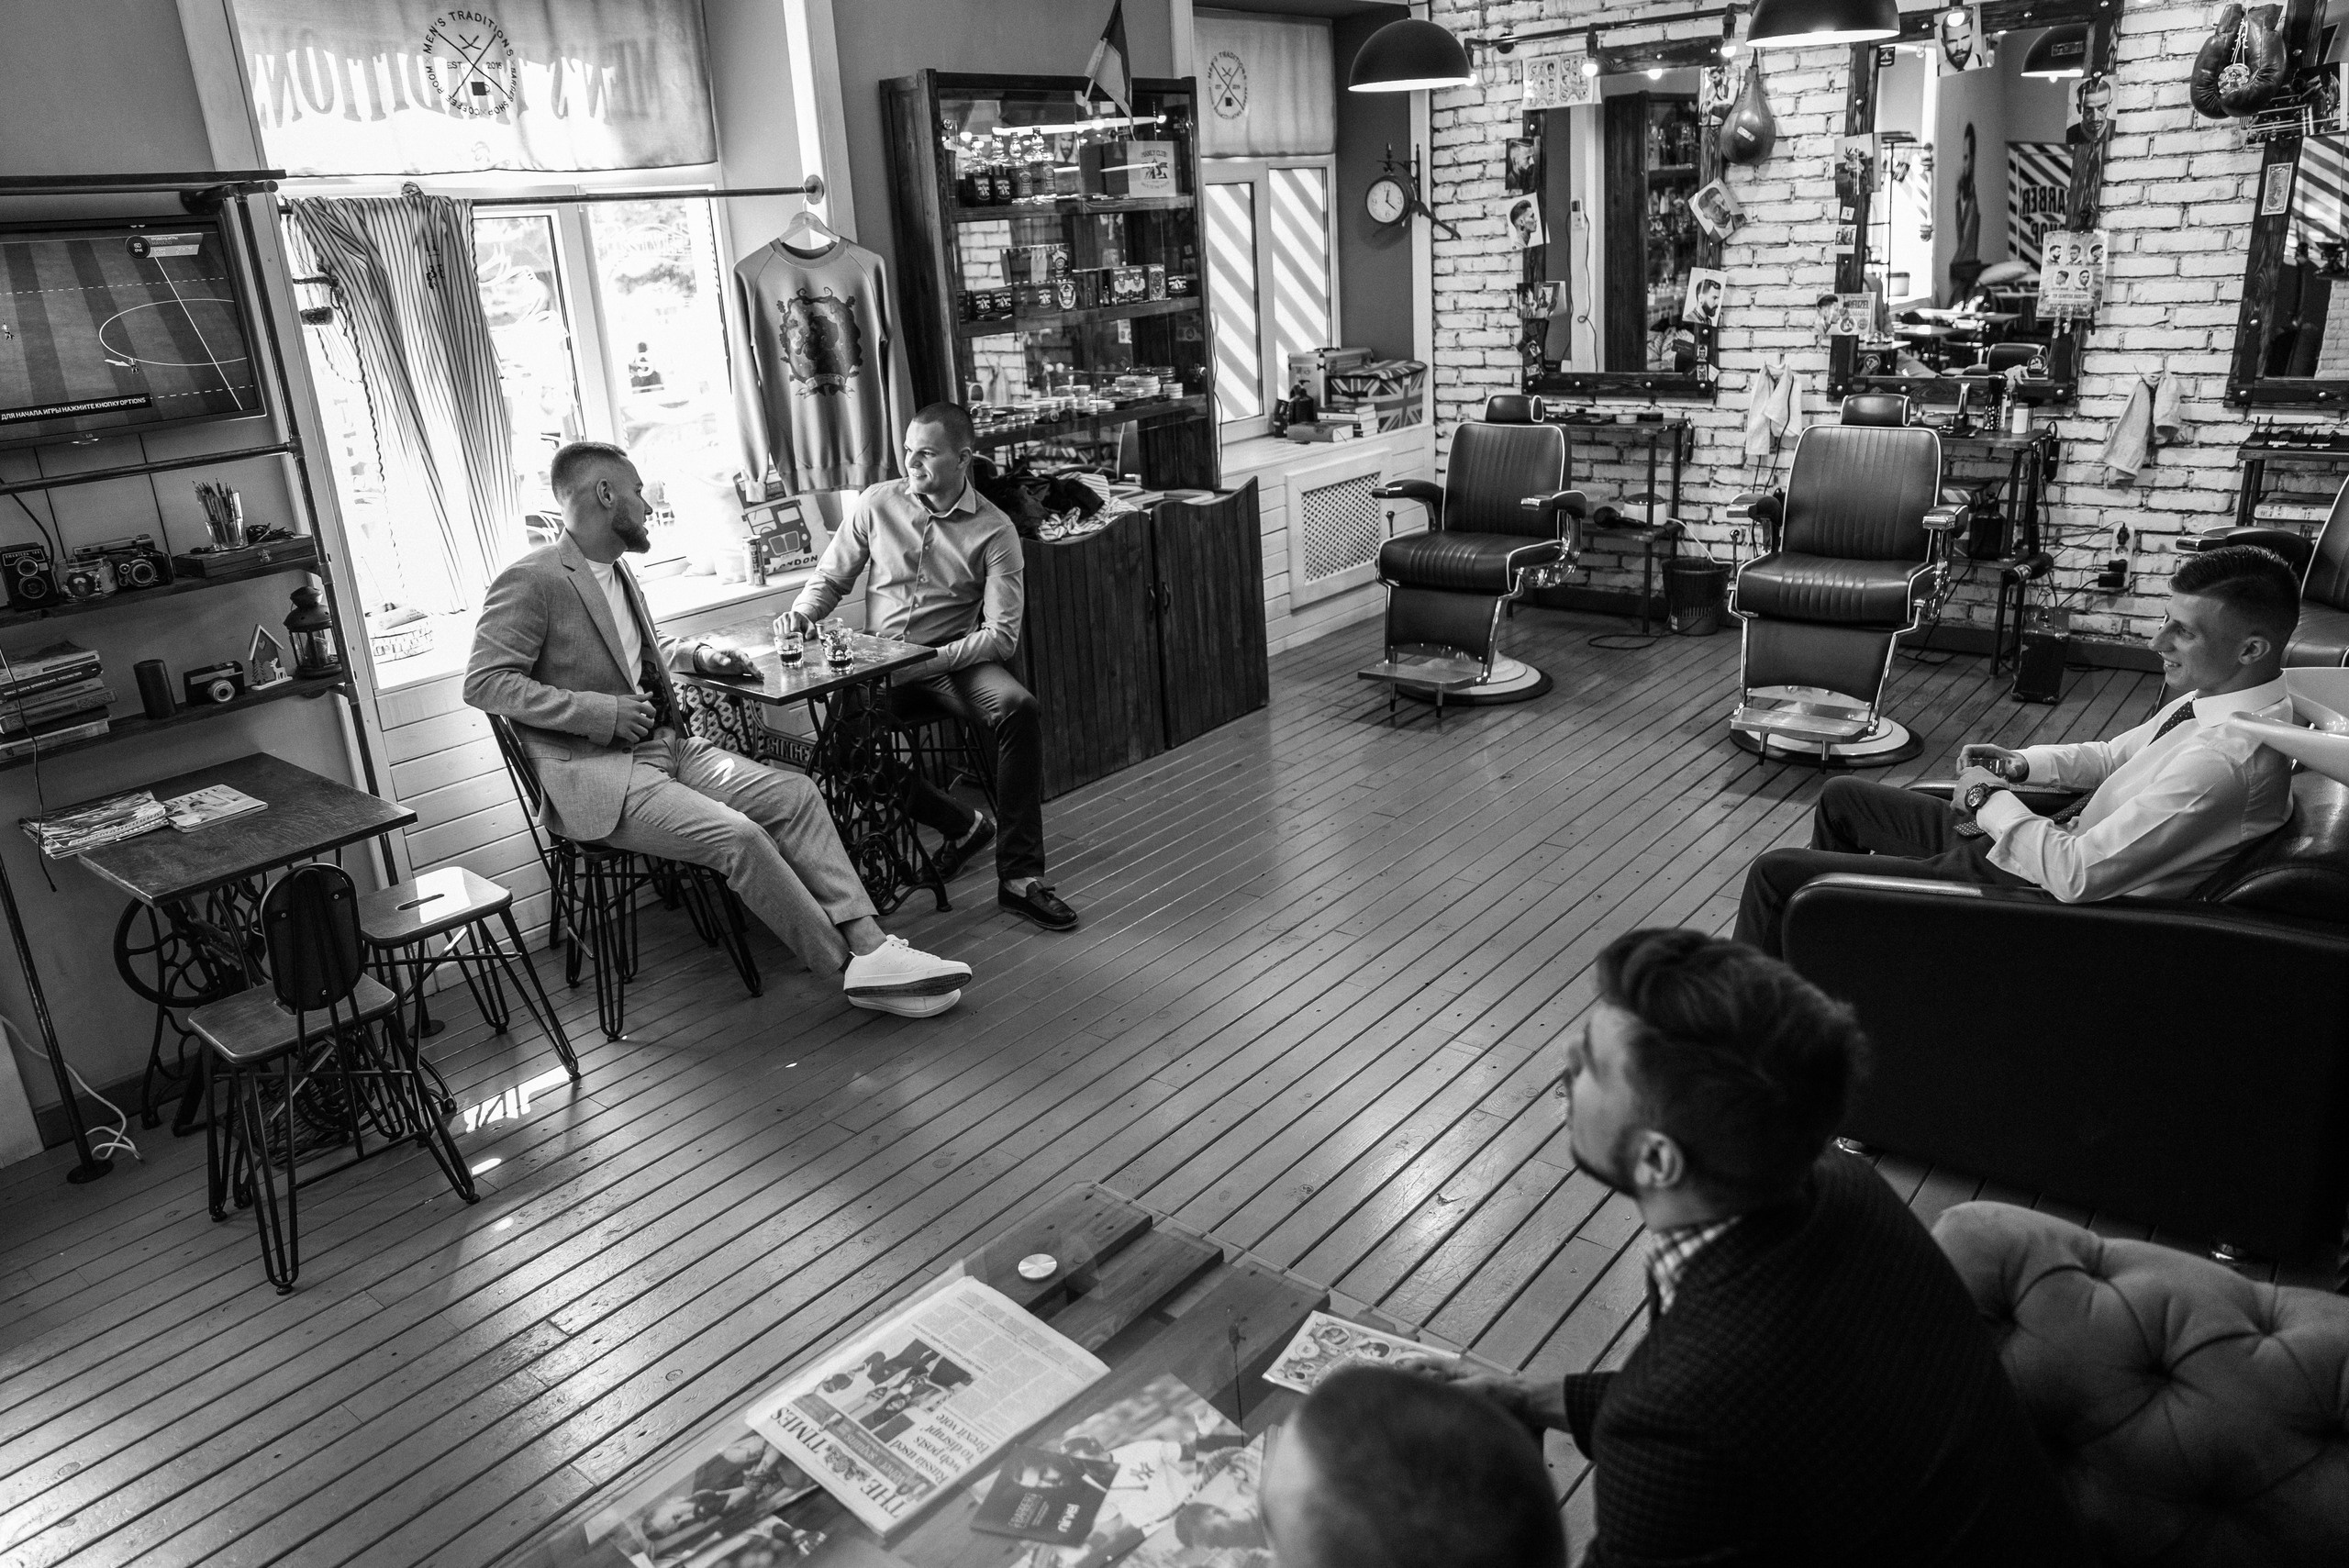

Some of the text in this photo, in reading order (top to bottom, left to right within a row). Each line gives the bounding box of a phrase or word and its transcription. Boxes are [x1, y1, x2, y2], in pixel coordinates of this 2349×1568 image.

[423, 10, 514, 57] MEN'S TRADITIONS
[425, 65, 444, 95] ROOM
[16, 409, 43, 418] НАЧАЛА
[43, 407, 61, 416] ИГРЫ
[61, 403, 95, 413] НАЖМИТЕ
[95, 400, 119, 409] КНОПКУ
[120, 397, 146, 406] OPTIONS
[771, 1406, 829, 1455] TIMES
[933, 1411, 989, 1453] Brexit vote
[888, 1439, 918, 1462] used
[911, 1434, 963, 1473] web posts
[912, 1454, 949, 1484] Russia
[860, 1473, 908, 1518] THE
[1058, 1504, 1080, 1532] nirvel
